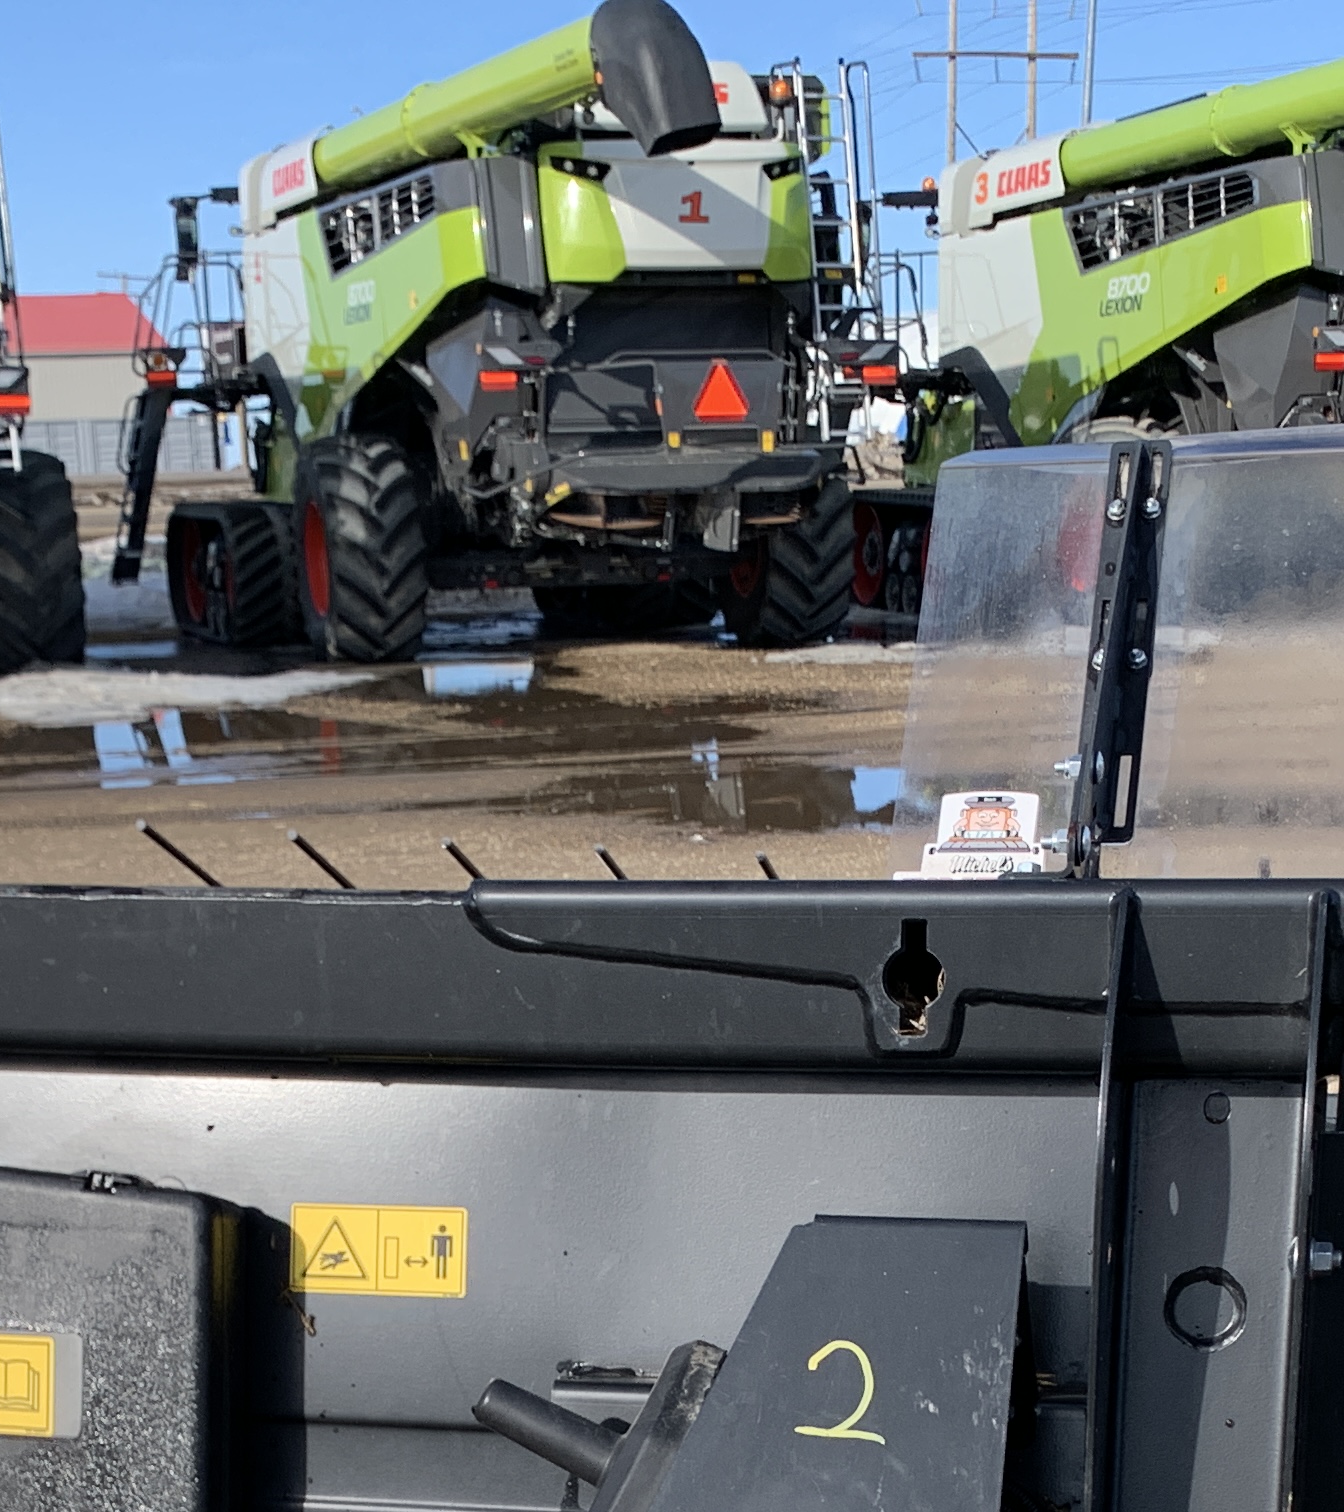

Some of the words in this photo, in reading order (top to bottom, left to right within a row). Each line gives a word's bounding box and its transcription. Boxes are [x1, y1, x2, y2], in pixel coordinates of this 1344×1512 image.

[975, 171, 989, 206] 3
[997, 159, 1051, 198] CLAAS
[679, 190, 710, 224] 1
[1107, 272, 1151, 300] 8700
[1099, 294, 1143, 318] LEXION
[949, 854, 1014, 874] Michel's
[794, 1340, 886, 1446] 2
